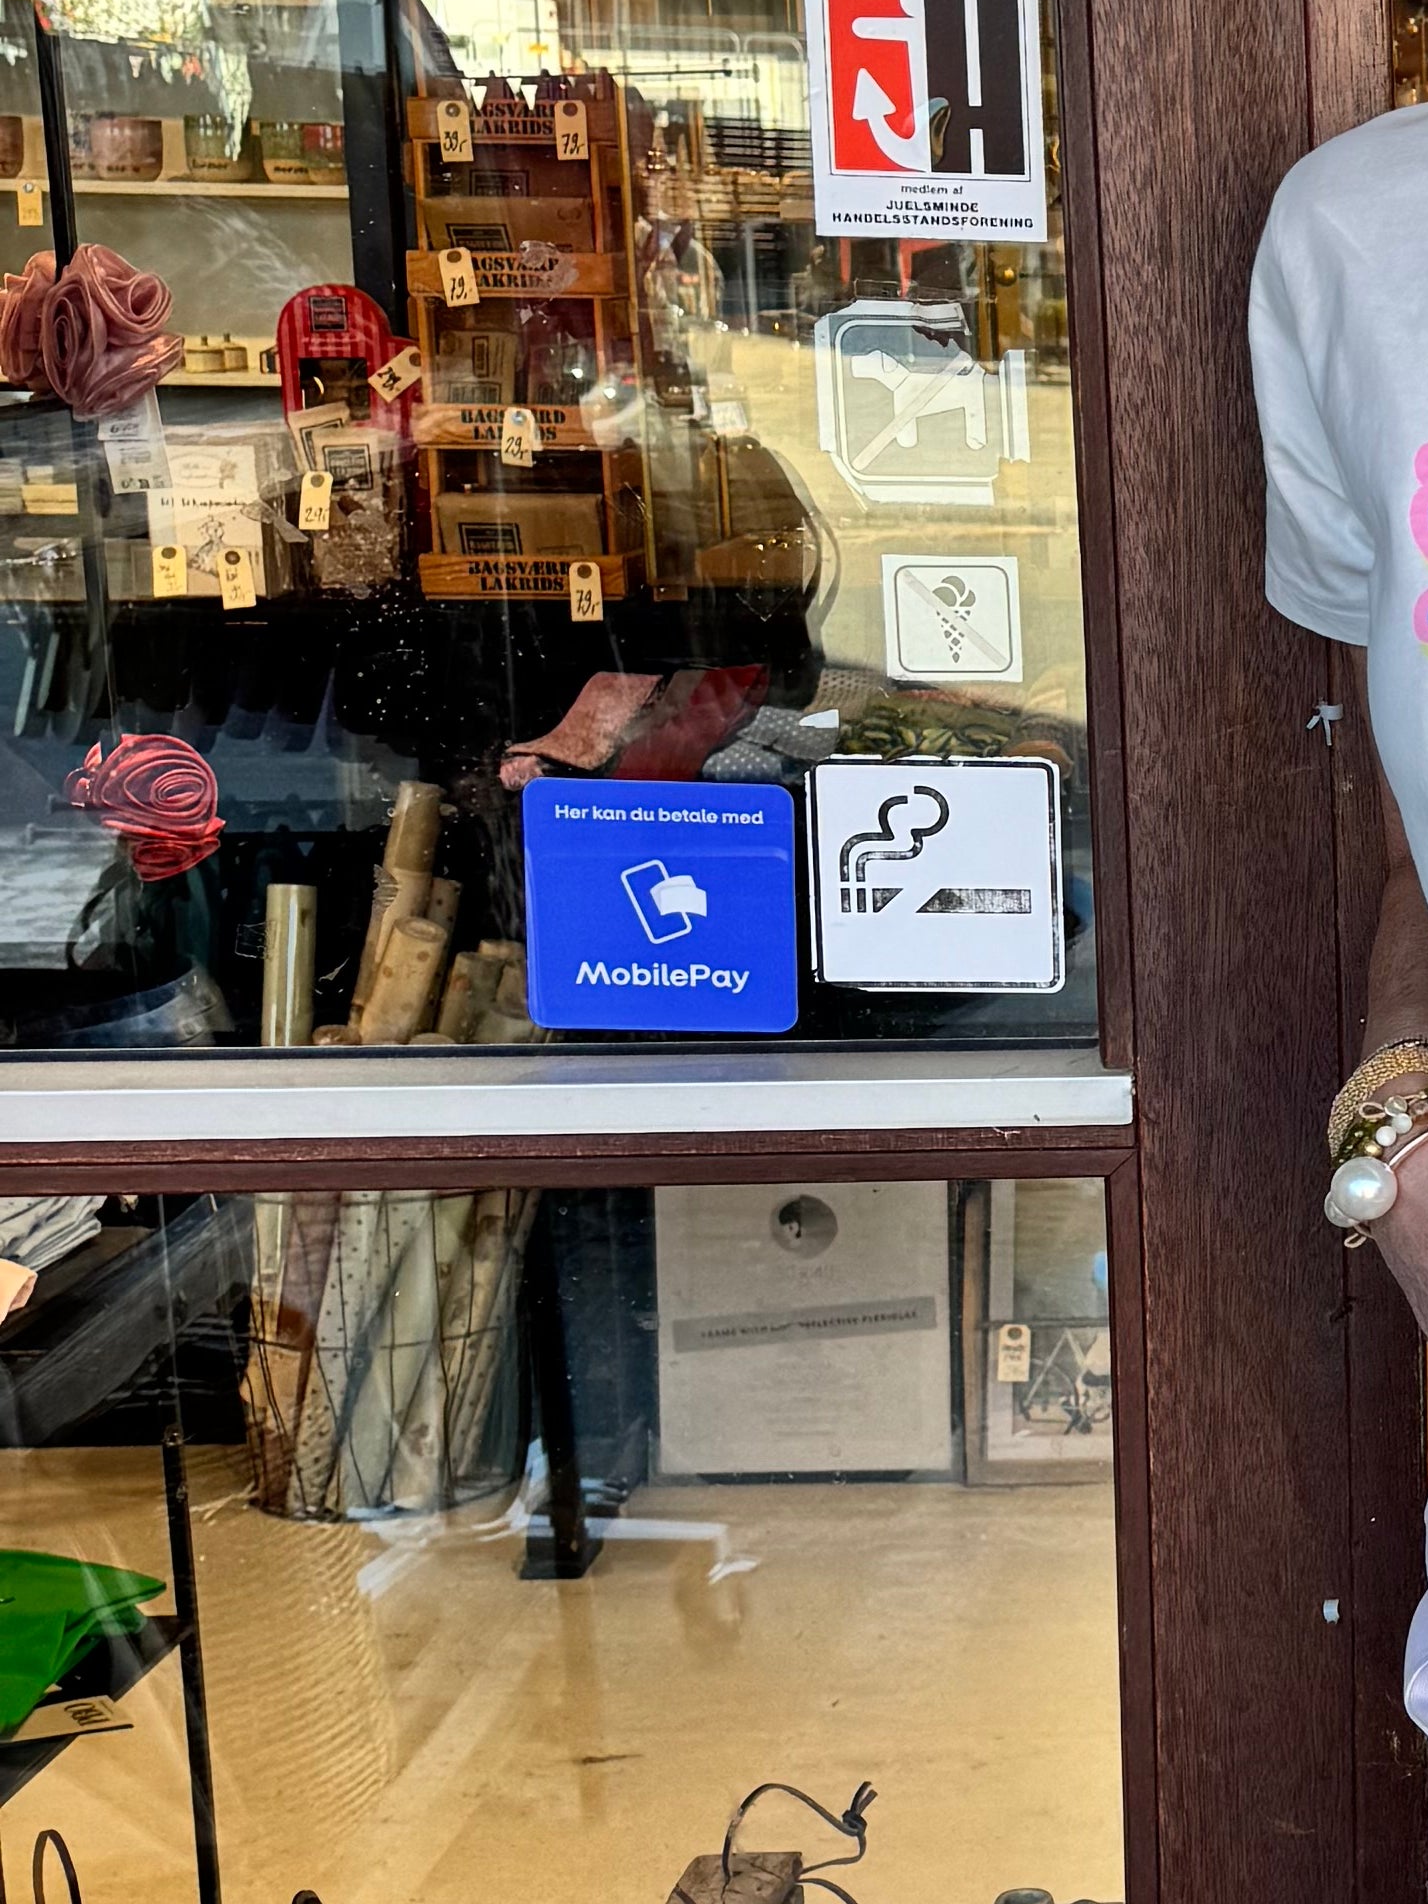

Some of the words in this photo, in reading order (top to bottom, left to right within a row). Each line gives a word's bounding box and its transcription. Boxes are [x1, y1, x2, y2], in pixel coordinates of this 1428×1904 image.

[900, 185, 948, 195] medlem
[952, 185, 964, 195] af
[886, 199, 980, 213] JUELSMINDE
[480, 576, 564, 592] LAKRIDS
[554, 804, 589, 819] Her
[592, 805, 627, 821] kan
[630, 807, 654, 822] du
[658, 807, 719, 824] betale
[721, 810, 765, 825] med
[575, 960, 750, 994] MobilePay
